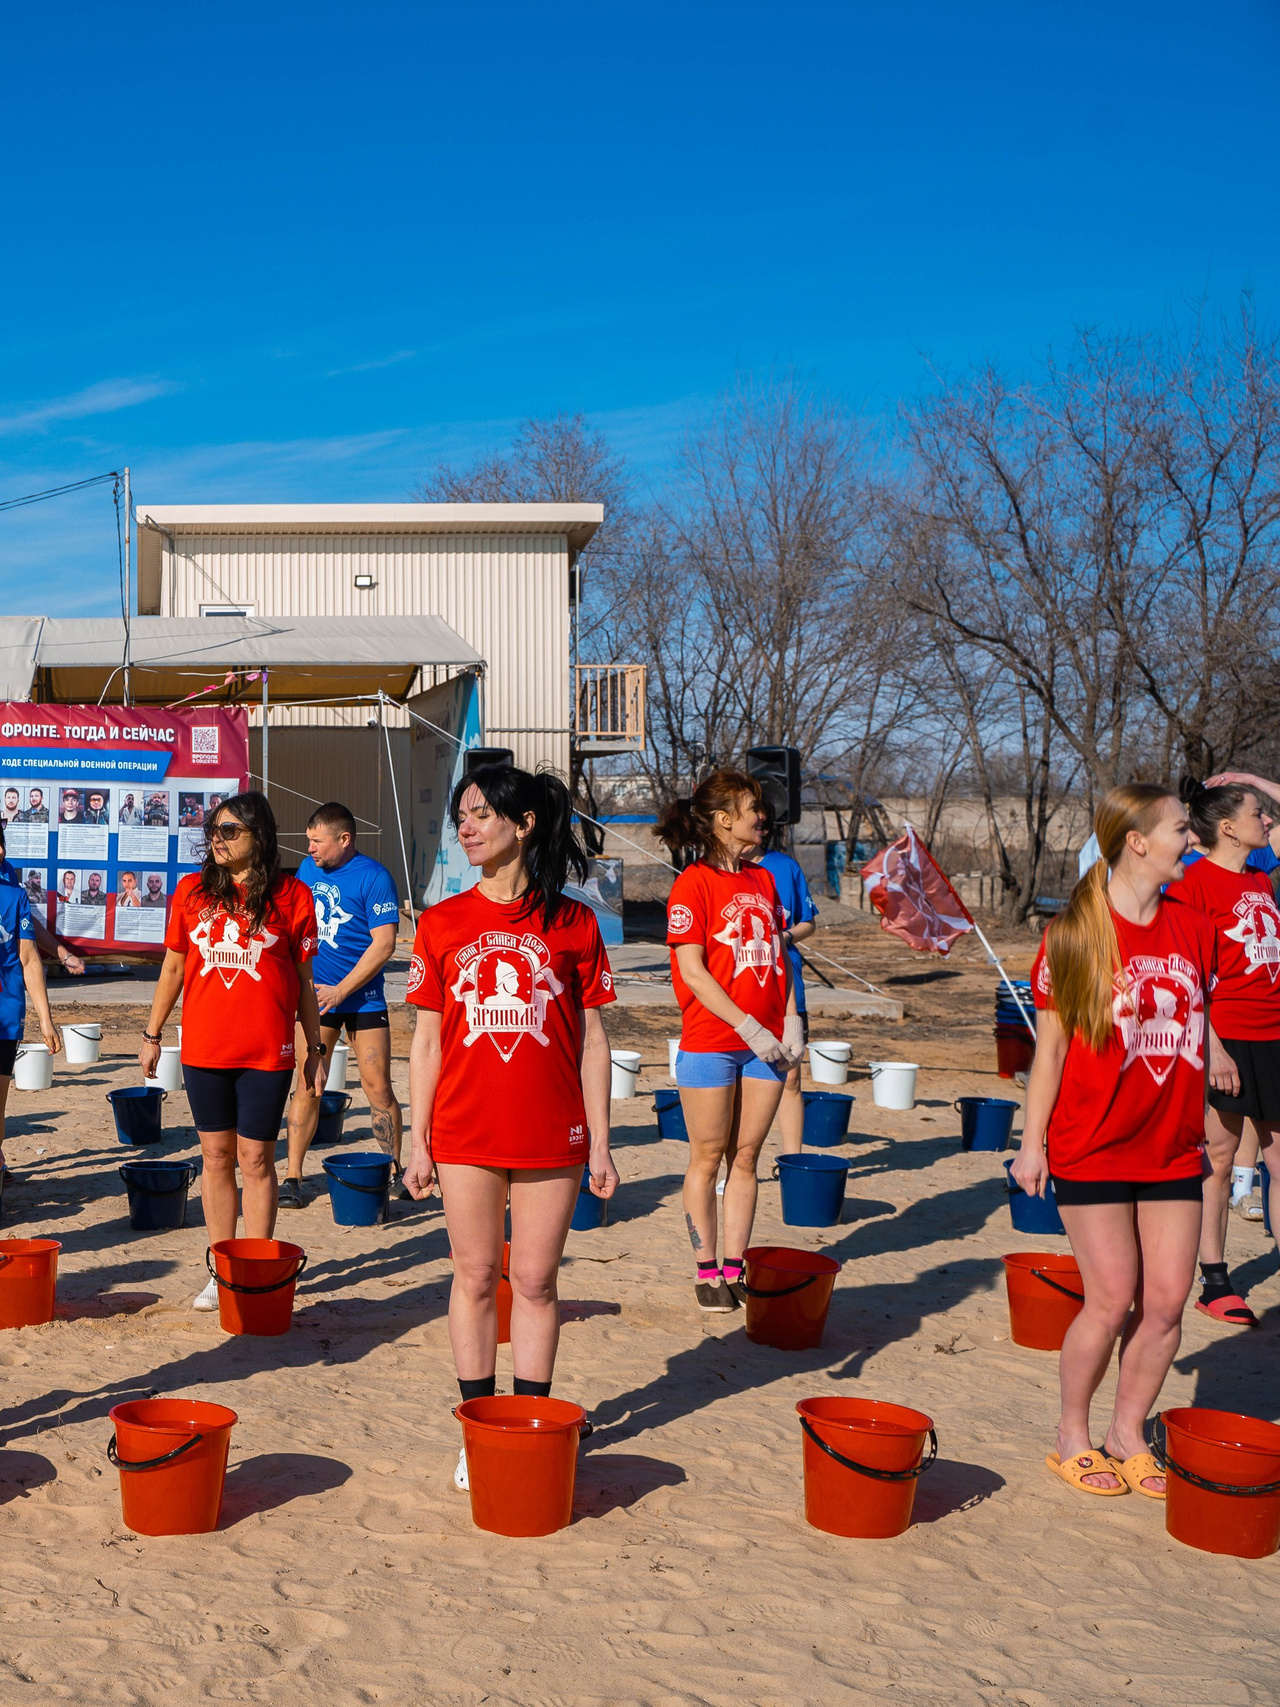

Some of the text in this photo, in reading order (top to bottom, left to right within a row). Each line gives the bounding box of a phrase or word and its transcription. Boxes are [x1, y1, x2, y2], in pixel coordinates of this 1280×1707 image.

[1, 722, 61, 739] ФРОНТЕ.
[64, 725, 106, 741] ТОГДА
[109, 726, 119, 740] И
[122, 724, 175, 742] СЕЙЧАС
[2, 759, 22, 767] ХОДЕ
[23, 758, 79, 769] СПЕЦИАЛЬНОЙ
[81, 759, 116, 770] ВОЕННОЙ
[118, 762, 158, 771] ОПЕРАЦИИ
[460, 934, 548, 965] СИЛА СЛАВА ДОЛГ
[473, 1005, 538, 1026] ЯРОПОЛК
[568, 1134, 585, 1142] SPORT
